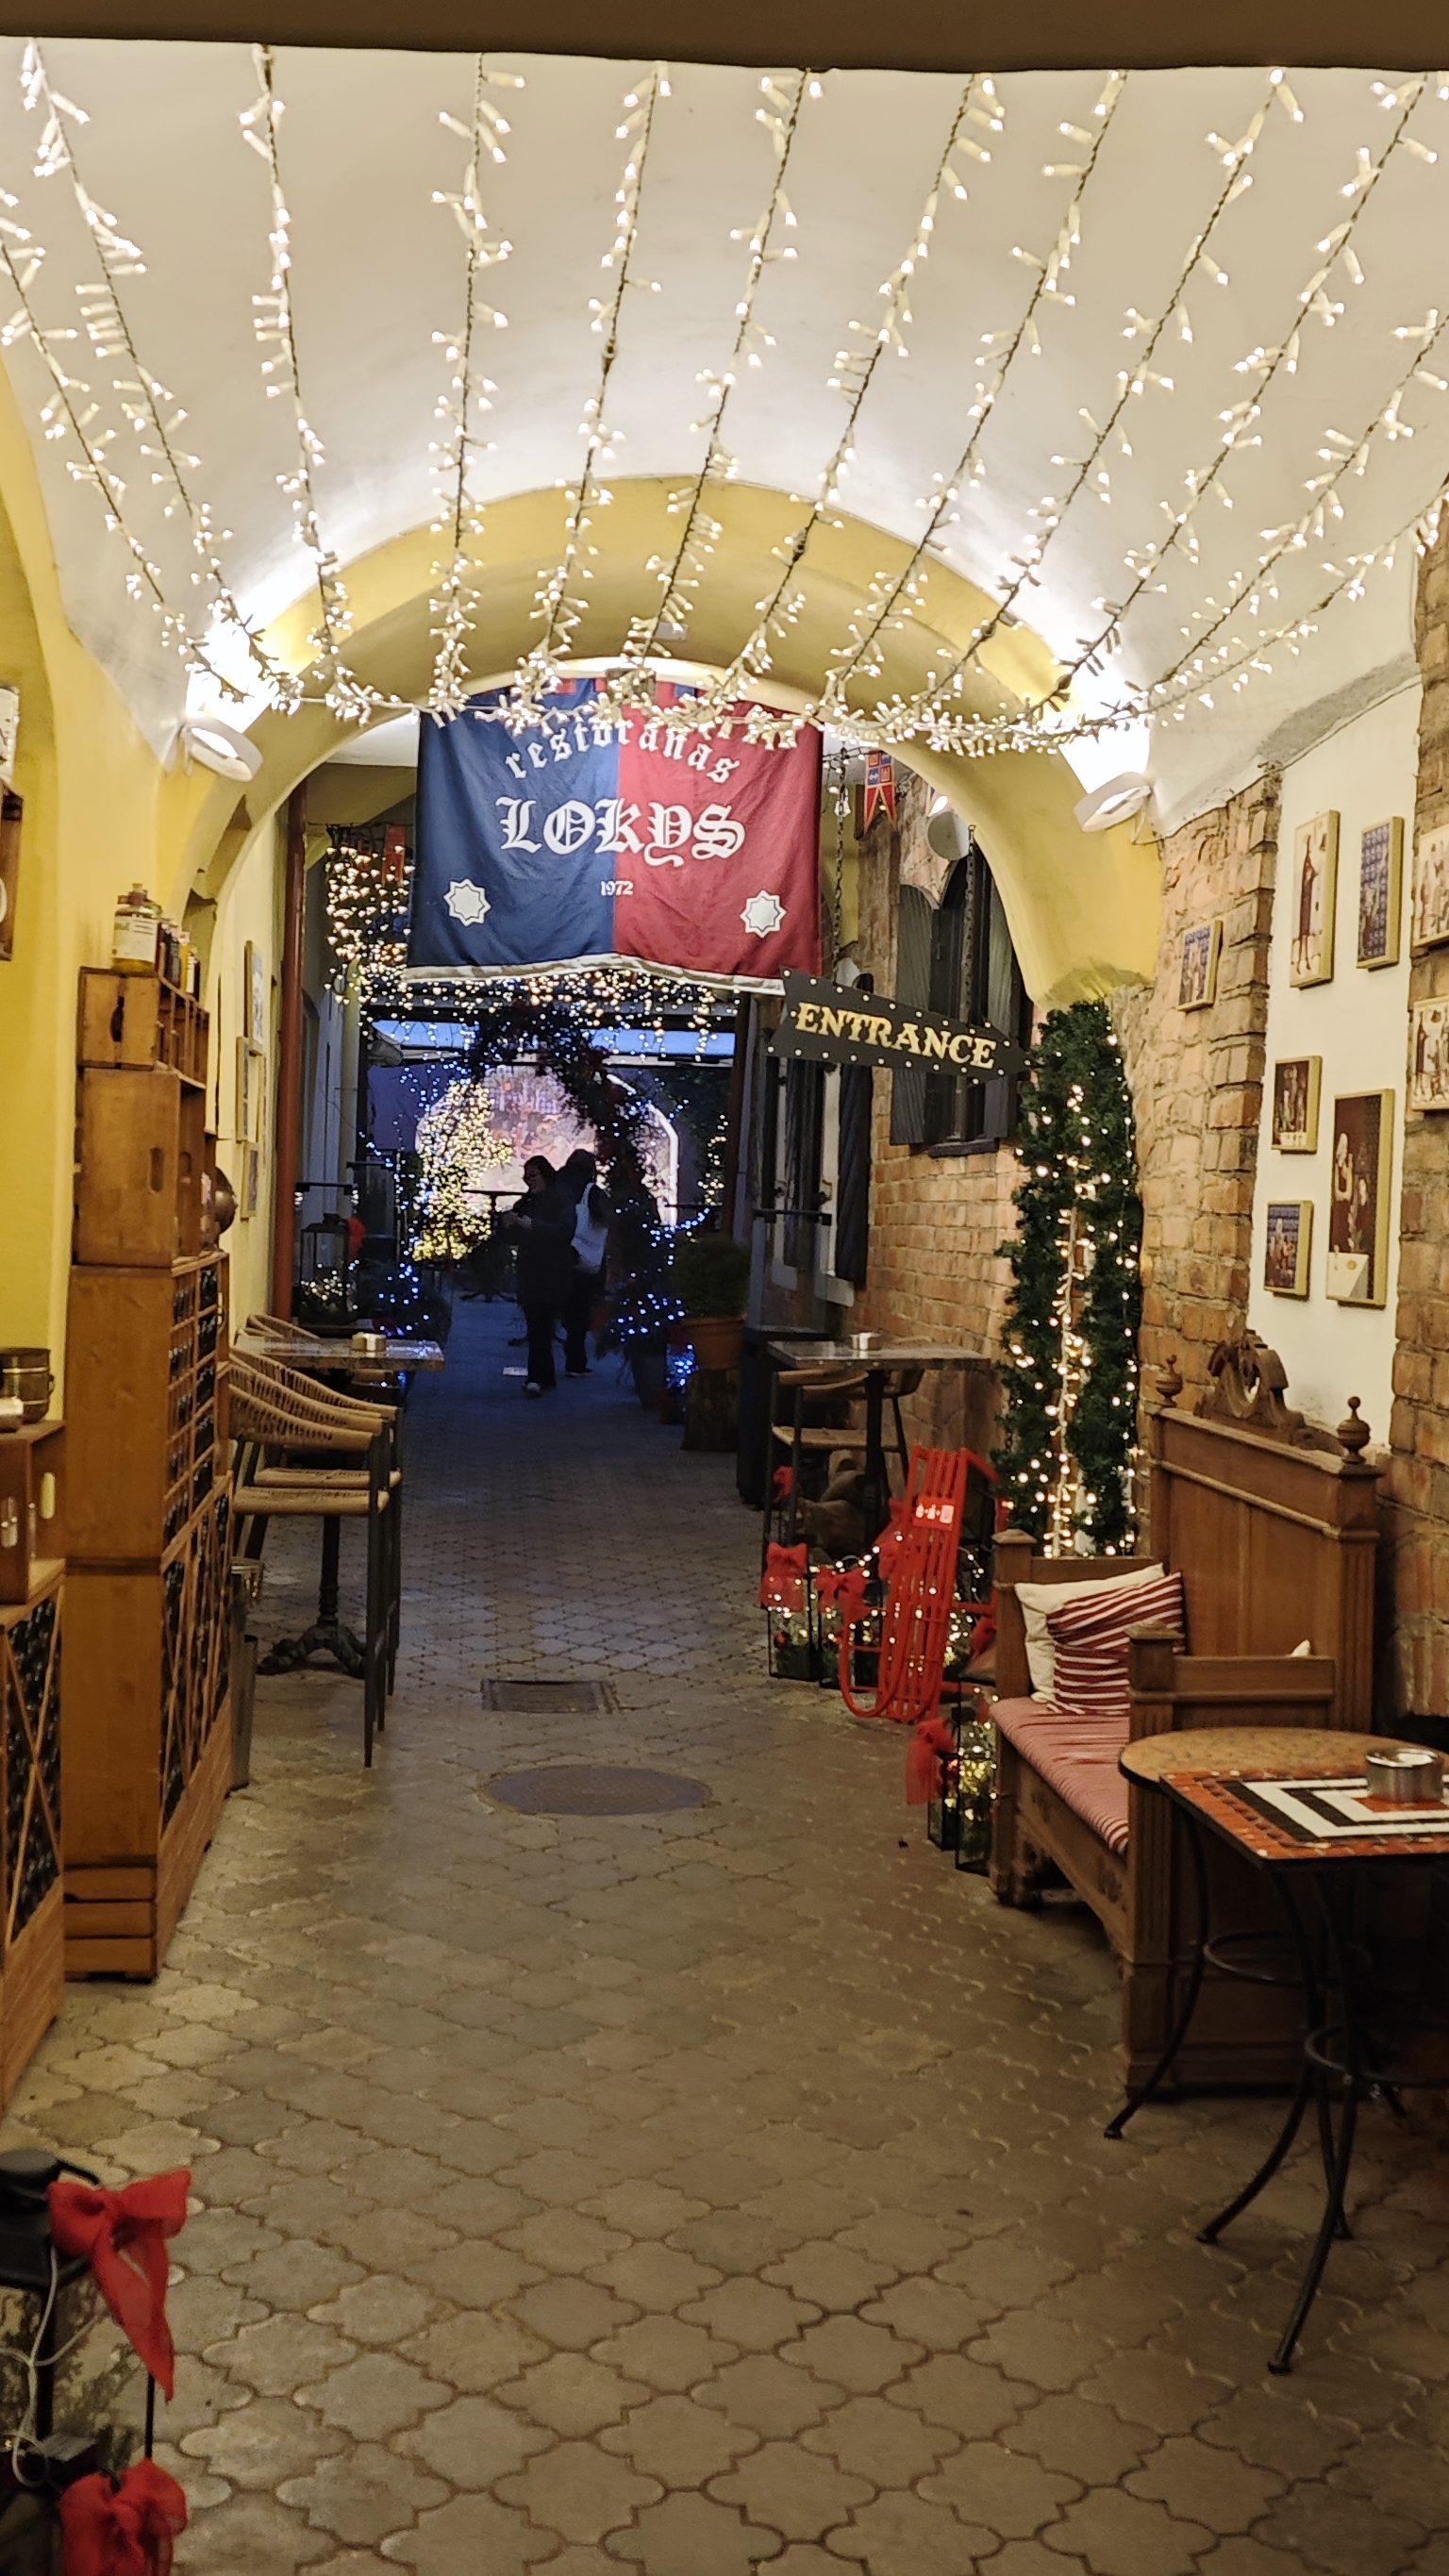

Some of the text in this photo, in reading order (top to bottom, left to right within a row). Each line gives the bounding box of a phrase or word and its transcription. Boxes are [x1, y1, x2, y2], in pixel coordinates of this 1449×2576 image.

[506, 719, 741, 784] restoranas
[495, 796, 746, 867] LOKYS
[600, 880, 634, 896] 1972
[795, 1001, 997, 1070] ENTRANCE
